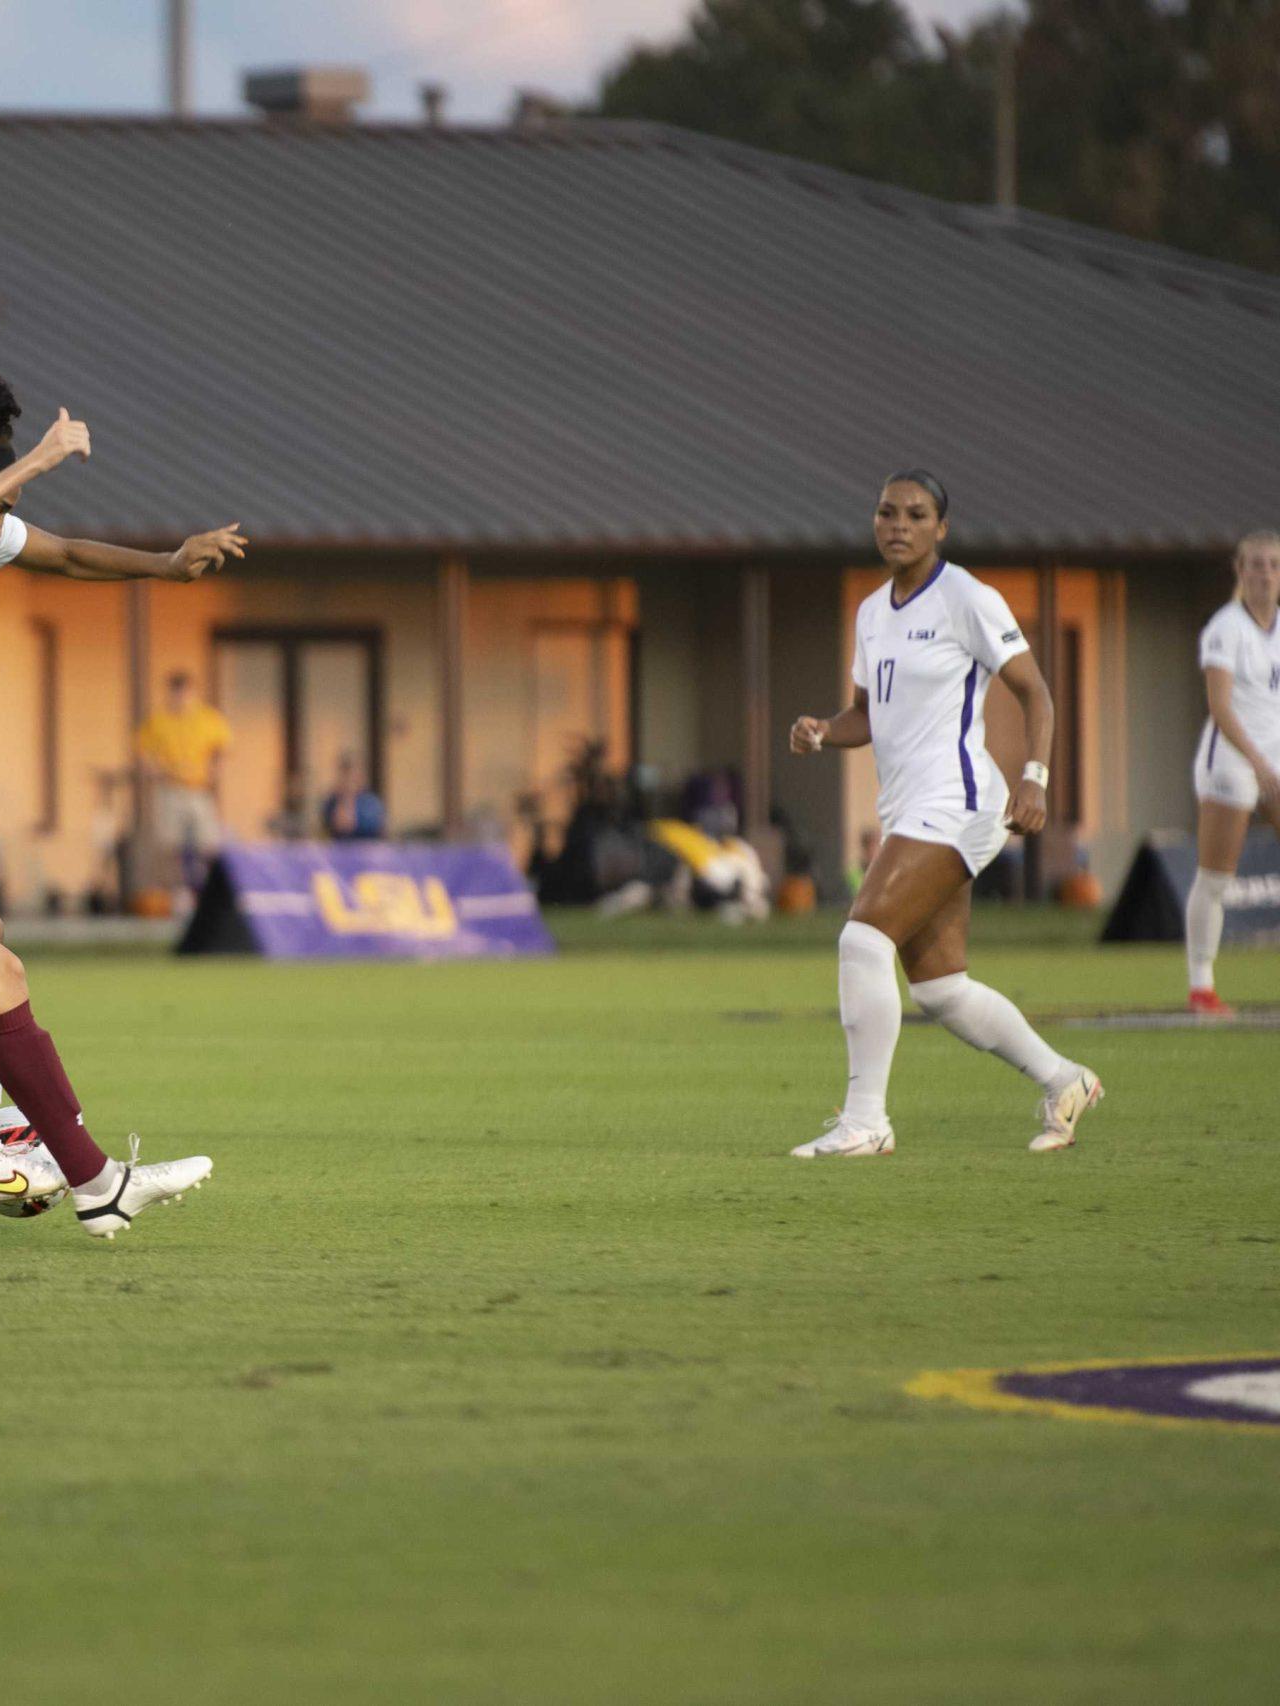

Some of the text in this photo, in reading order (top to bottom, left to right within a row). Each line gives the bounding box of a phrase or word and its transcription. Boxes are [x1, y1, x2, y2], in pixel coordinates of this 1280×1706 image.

[907, 629, 936, 641] LSU
[877, 658, 896, 703] 17
[313, 871, 458, 939] LSU
